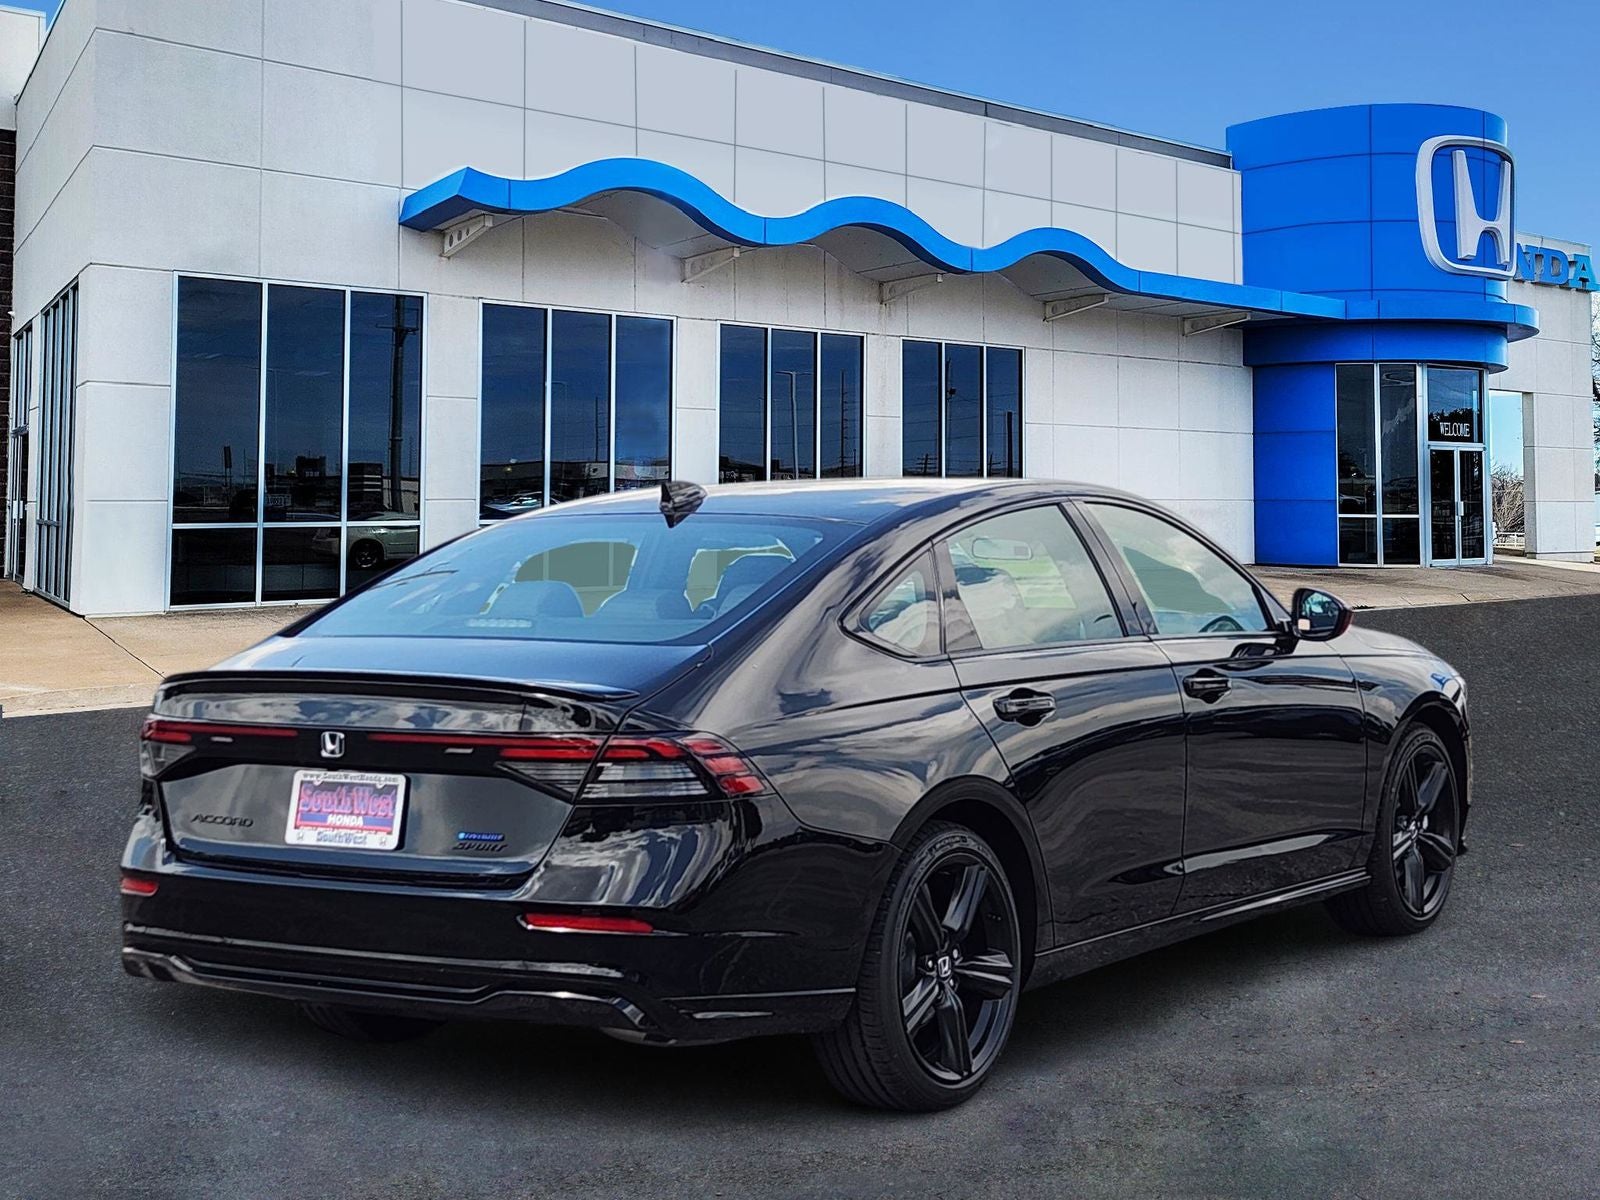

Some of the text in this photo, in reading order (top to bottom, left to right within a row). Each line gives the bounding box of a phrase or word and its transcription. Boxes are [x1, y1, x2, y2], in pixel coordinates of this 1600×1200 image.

[1439, 422, 1471, 437] WELCOME
[190, 813, 254, 828] ACCORD
[327, 813, 364, 826] HONDA
